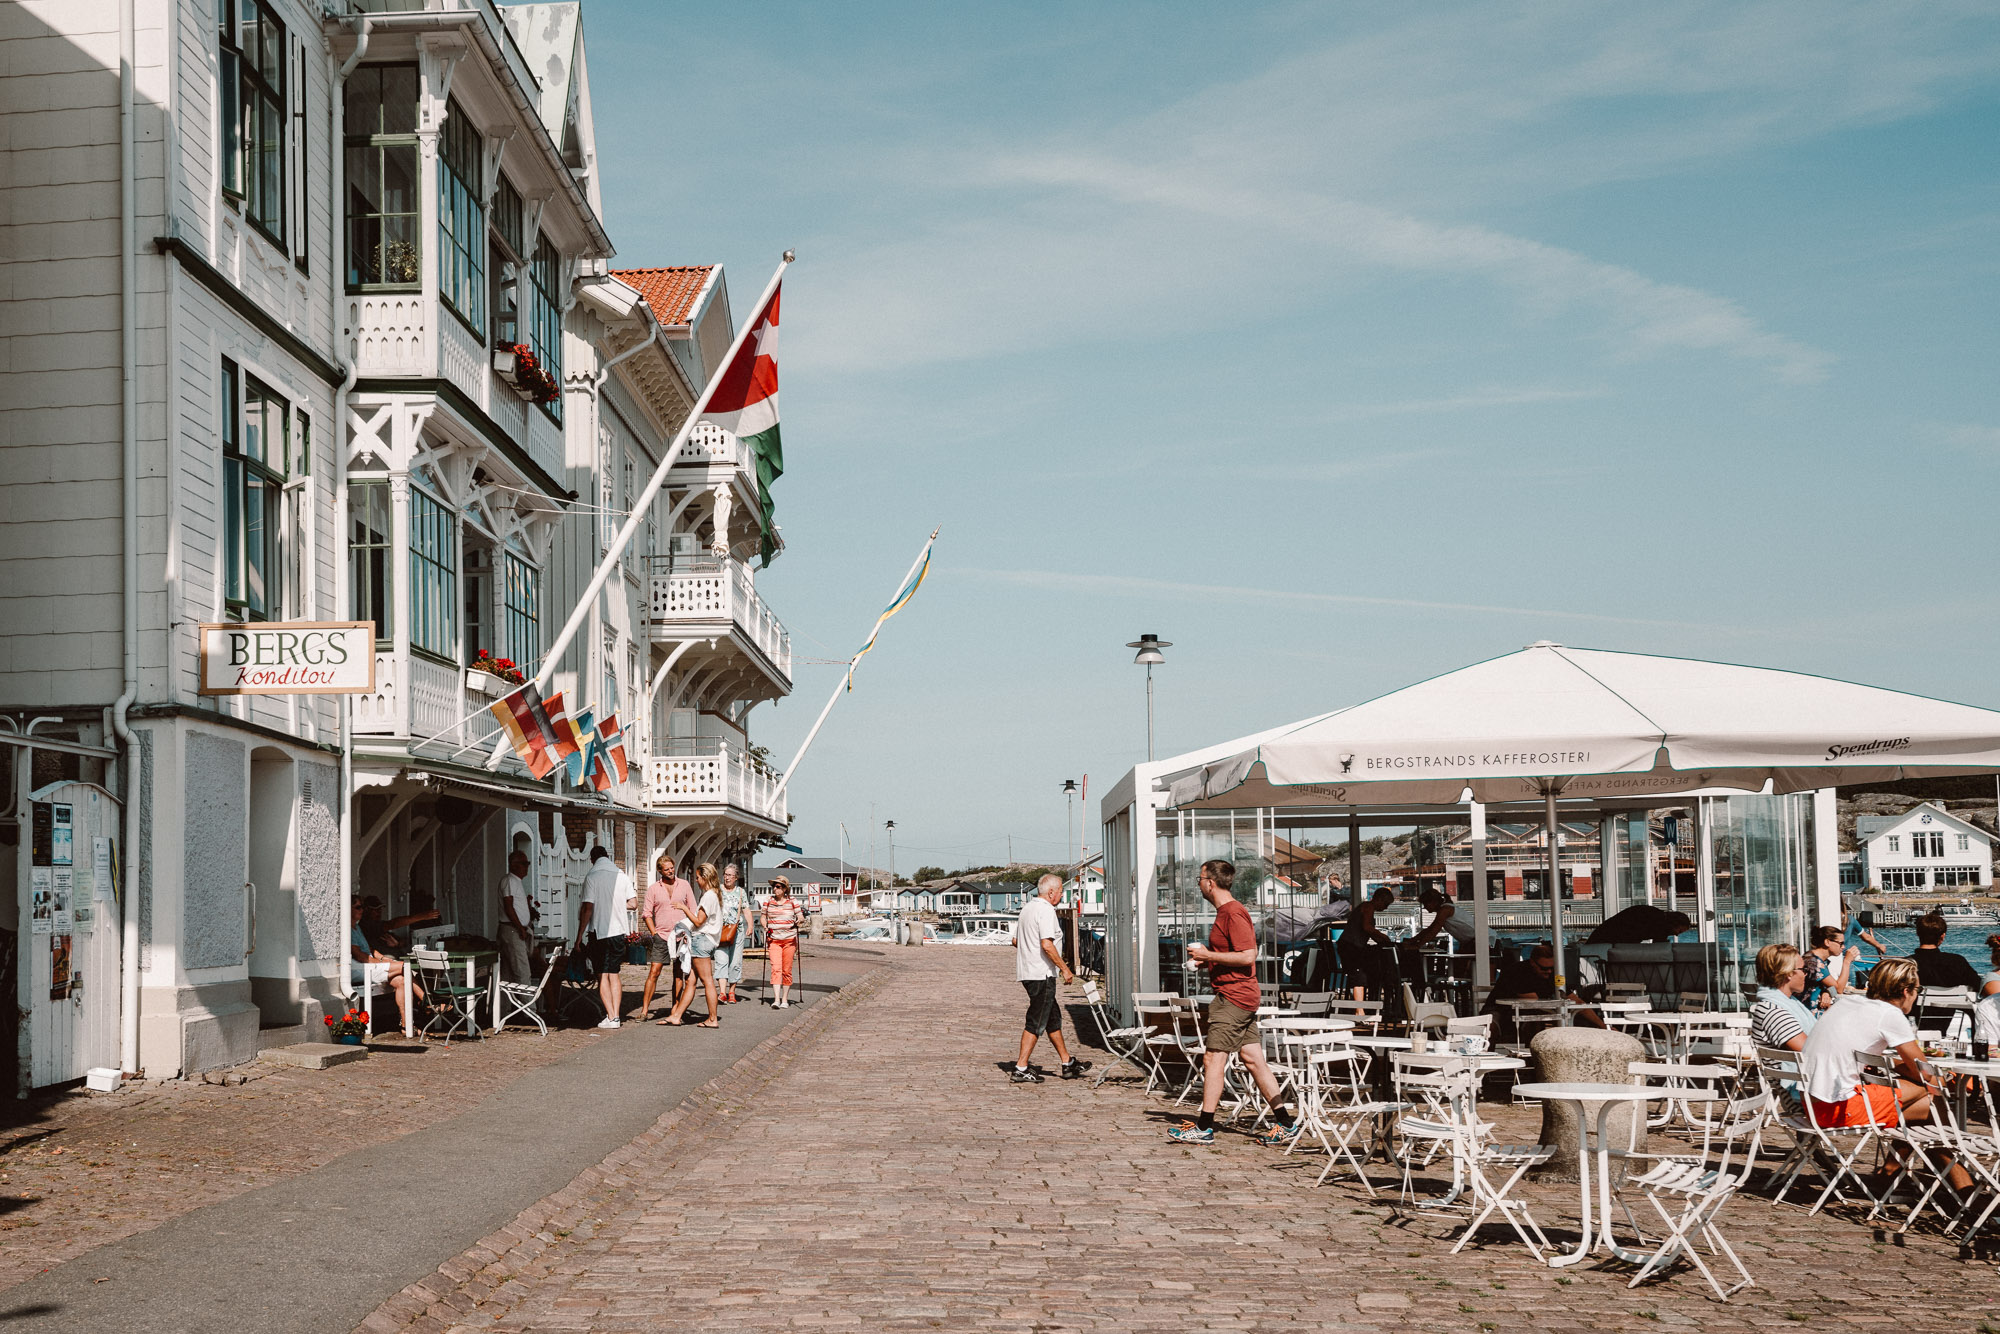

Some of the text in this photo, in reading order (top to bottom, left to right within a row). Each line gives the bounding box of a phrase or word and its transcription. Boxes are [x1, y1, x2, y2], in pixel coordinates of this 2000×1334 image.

[228, 631, 347, 666] BERGS
[234, 667, 337, 686] Konditori
[1825, 736, 1911, 761] Spendrups
[1366, 751, 1591, 770] BERGSTRANDS KAFFEROSTERI
[1665, 823, 1676, 838] W
